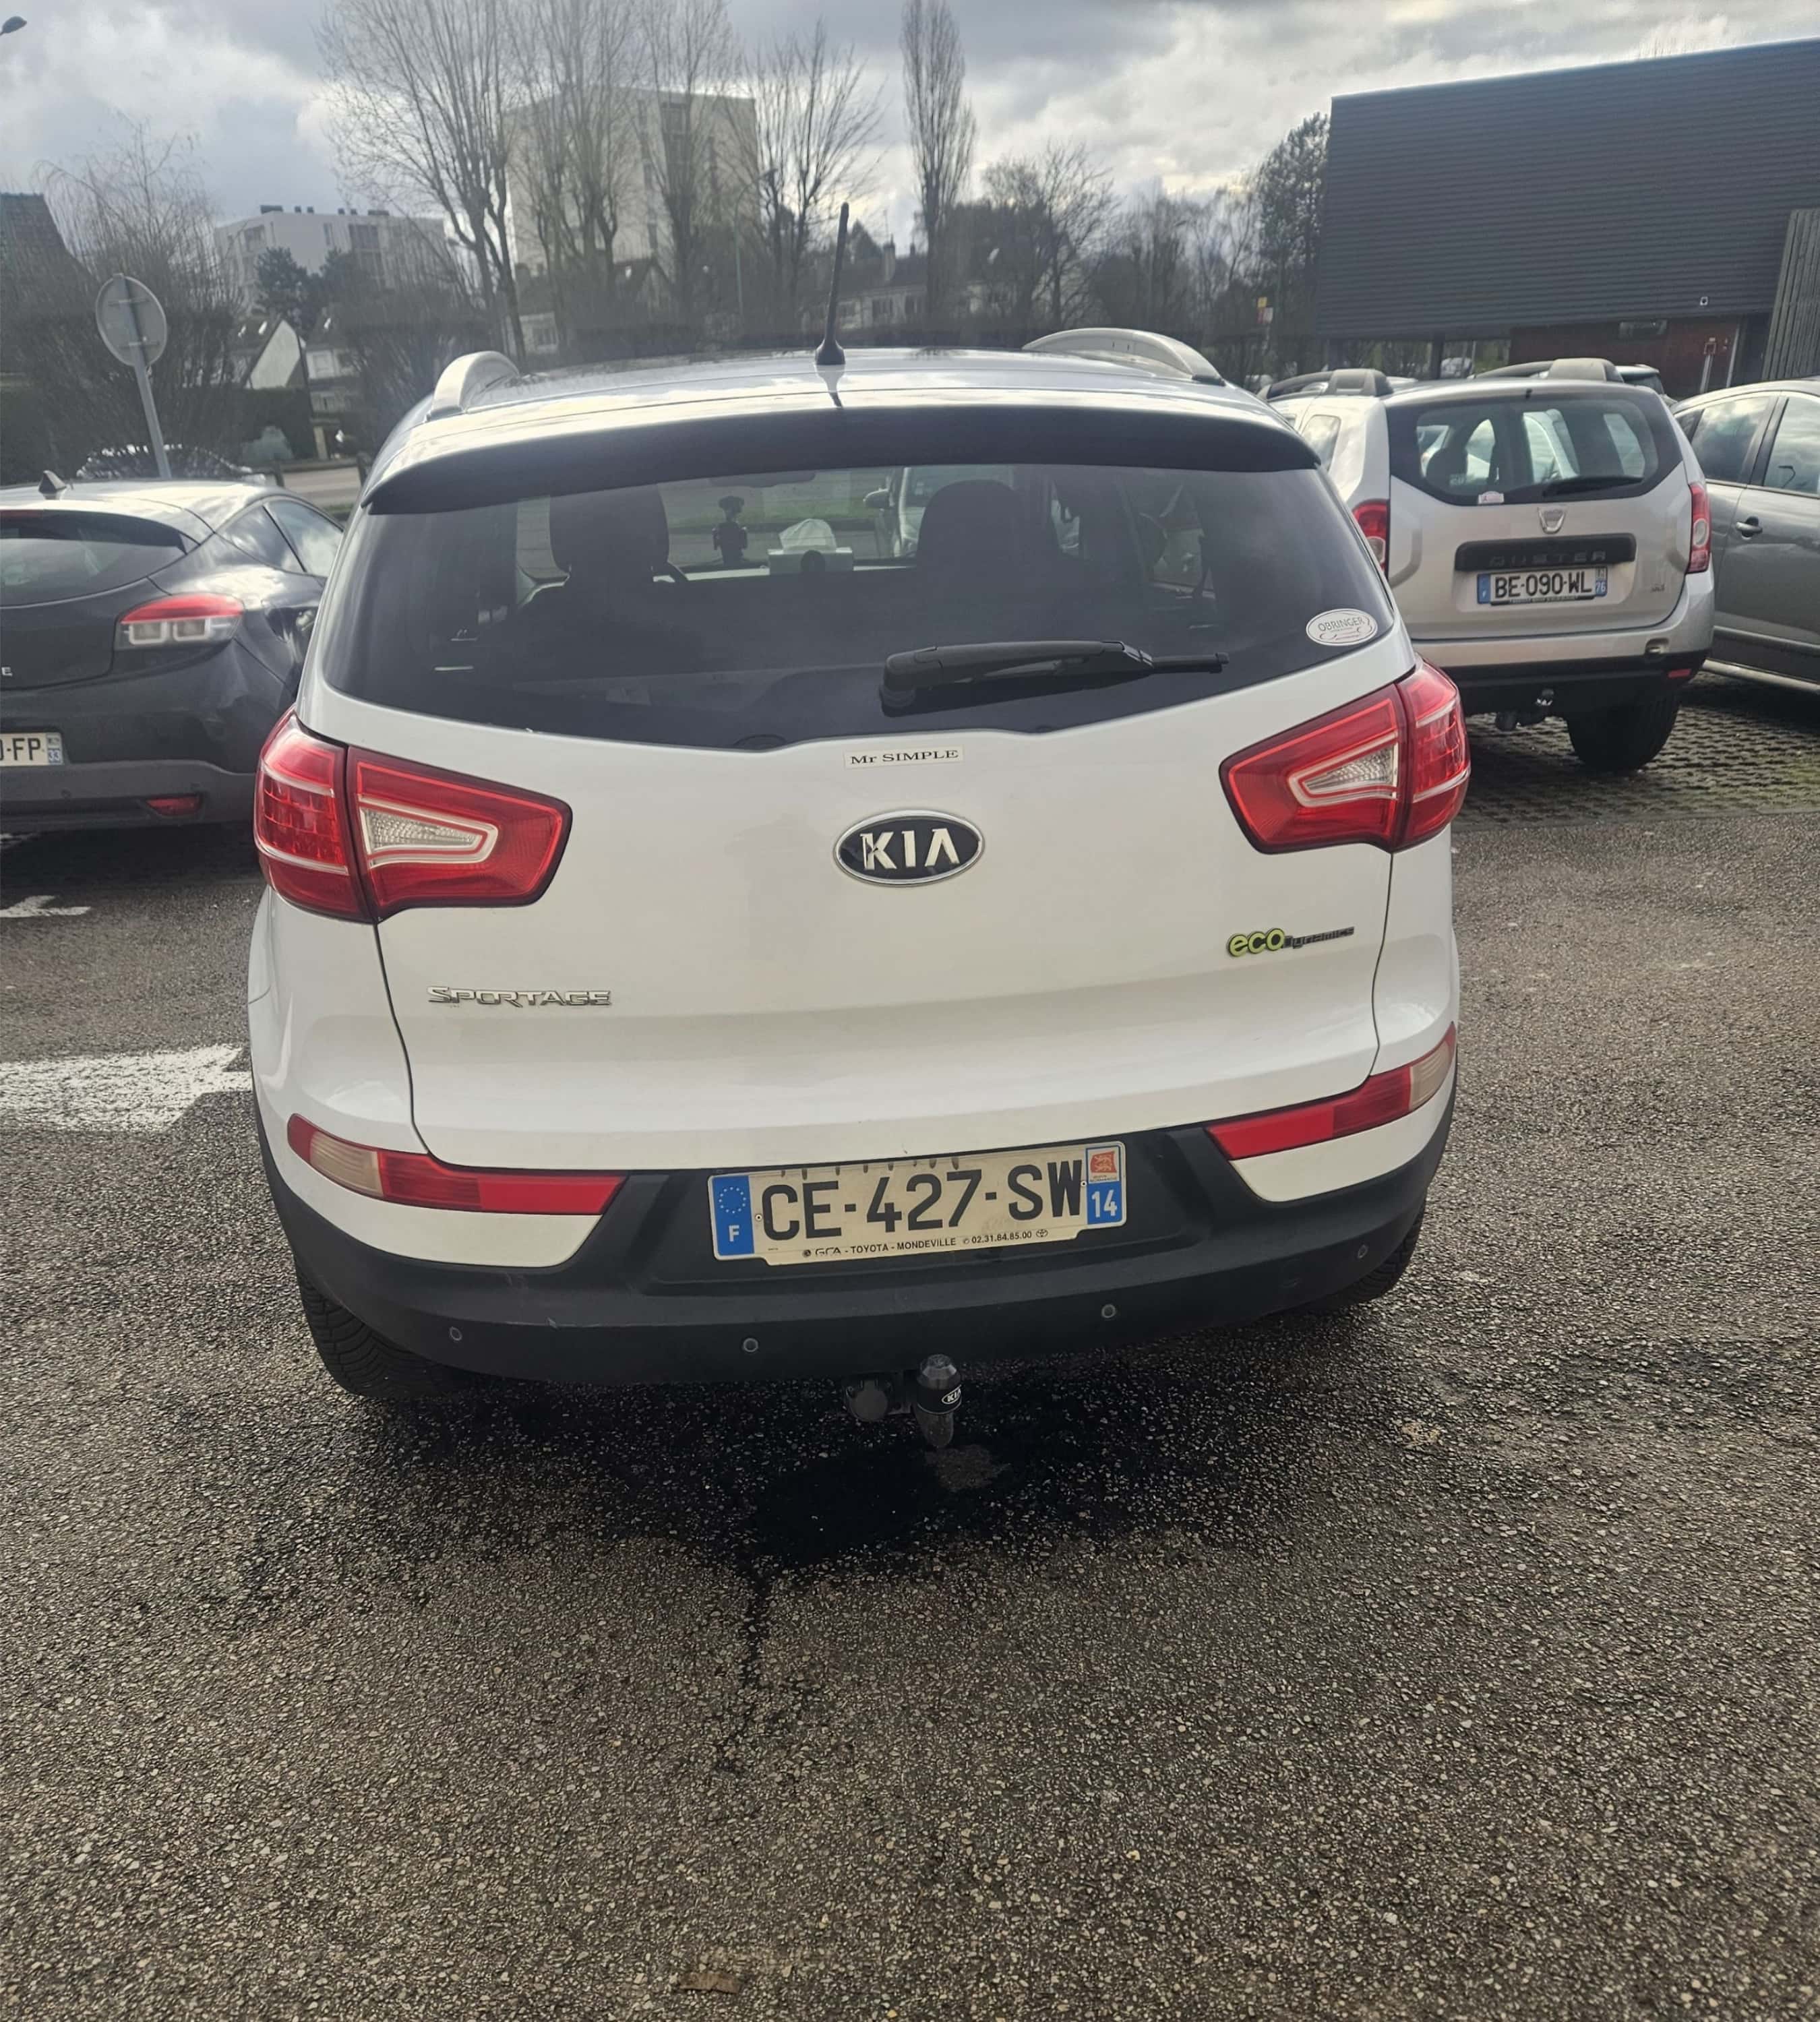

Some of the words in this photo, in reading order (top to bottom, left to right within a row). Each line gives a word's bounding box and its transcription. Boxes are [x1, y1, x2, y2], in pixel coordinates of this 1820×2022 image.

[1494, 572, 1592, 599] BE-090-WL
[1596, 582, 1606, 592] 76
[1318, 616, 1365, 632] OBRINGER
[851, 755, 877, 764] Mr
[882, 749, 959, 762] SIMPLE
[859, 828, 961, 870] KIA
[427, 986, 612, 1008] SPORTAGE
[762, 1159, 1083, 1241] CE-427-SW
[1091, 1189, 1118, 1218] 14
[729, 1225, 739, 1242] F
[851, 1243, 889, 1254] TOYOTA
[897, 1237, 957, 1251] MONDEVILLE
[971, 1230, 1033, 1244] 02.31.84.85.00
